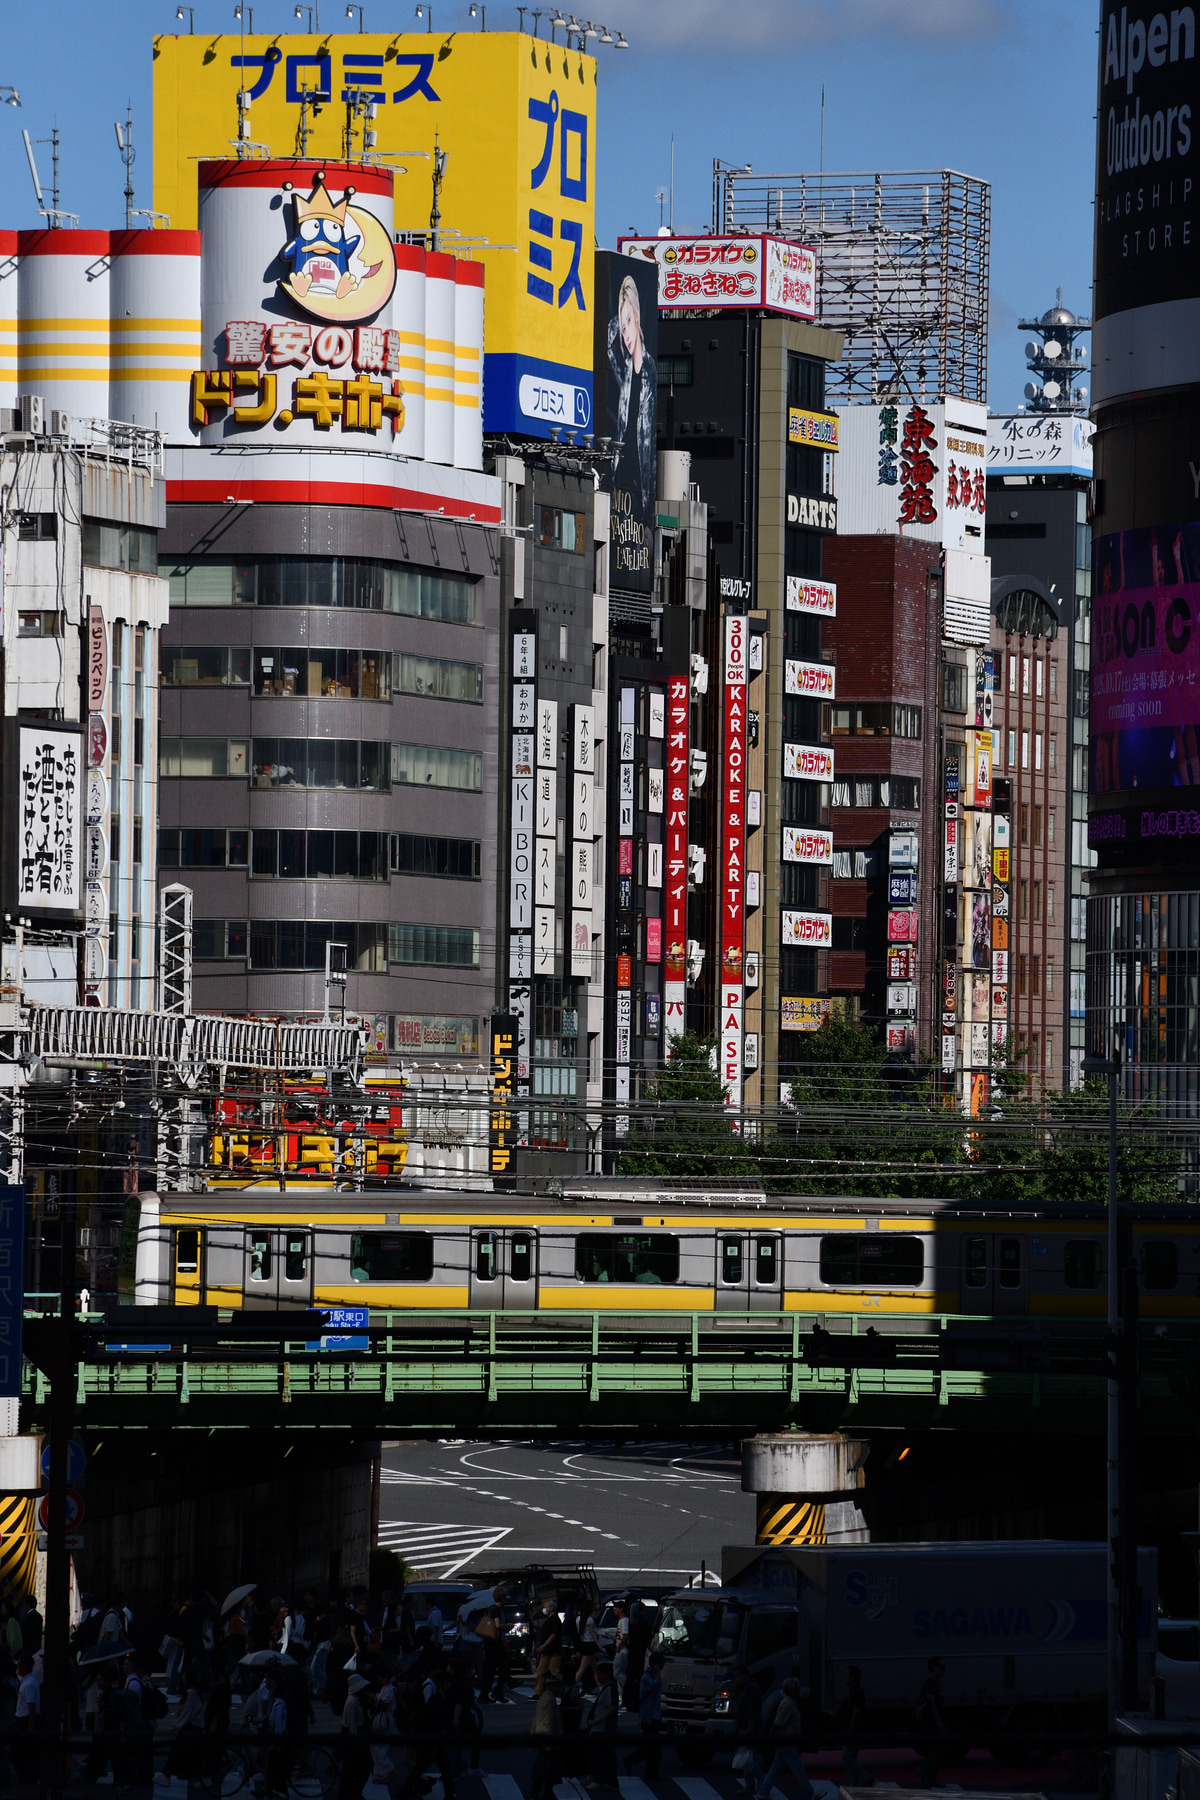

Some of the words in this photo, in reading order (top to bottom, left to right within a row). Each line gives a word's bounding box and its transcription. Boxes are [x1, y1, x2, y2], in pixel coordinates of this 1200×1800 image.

[1104, 5, 1196, 96] Alpen
[230, 46, 441, 104] プロミス
[1107, 96, 1192, 177] Outdoors
[1100, 177, 1193, 225] FLAGSHIP
[676, 245, 744, 264] カラオケ
[1122, 220, 1192, 258] STORE
[787, 251, 809, 273] カラオケ
[664, 267, 756, 300] まねきねこ
[782, 275, 812, 307] まねきねこ
[224, 320, 400, 373] 驚安の殿堂
[532, 386, 565, 417] プロミス
[1005, 420, 1063, 442] 水の森
[895, 405, 940, 526] 東海苑
[987, 444, 1062, 463] クリニック
[611, 486, 632, 517] MIO
[945, 458, 986, 515] 東海苑
[787, 494, 837, 531] DARTS
[609, 514, 645, 546] YASHIRO
[615, 546, 650, 571] L'ATELIER
[803, 583, 830, 610] カラオケ
[519, 637, 529, 675] 6年4組
[729, 619, 743, 663] 300
[727, 670, 744, 680] OK
[802, 669, 828, 693] カラオケ
[519, 688, 529, 724] おかか
[1137, 699, 1162, 717] soon
[670, 682, 687, 774] カラオケ
[728, 687, 743, 803] KARAOKE
[801, 753, 827, 775] カラオケ
[671, 787, 684, 802] &
[728, 814, 741, 826] &
[515, 783, 528, 923] KIBORI
[800, 836, 826, 858] カラオケ
[89, 869, 101, 878] 6F
[668, 811, 687, 926] パーティー
[727, 837, 741, 919] PARTY
[799, 919, 825, 942] カラオケ
[621, 993, 631, 1023] ZEST
[862, 1295, 881, 1307] JR
[912, 1607, 1033, 1641] SAGAWA
